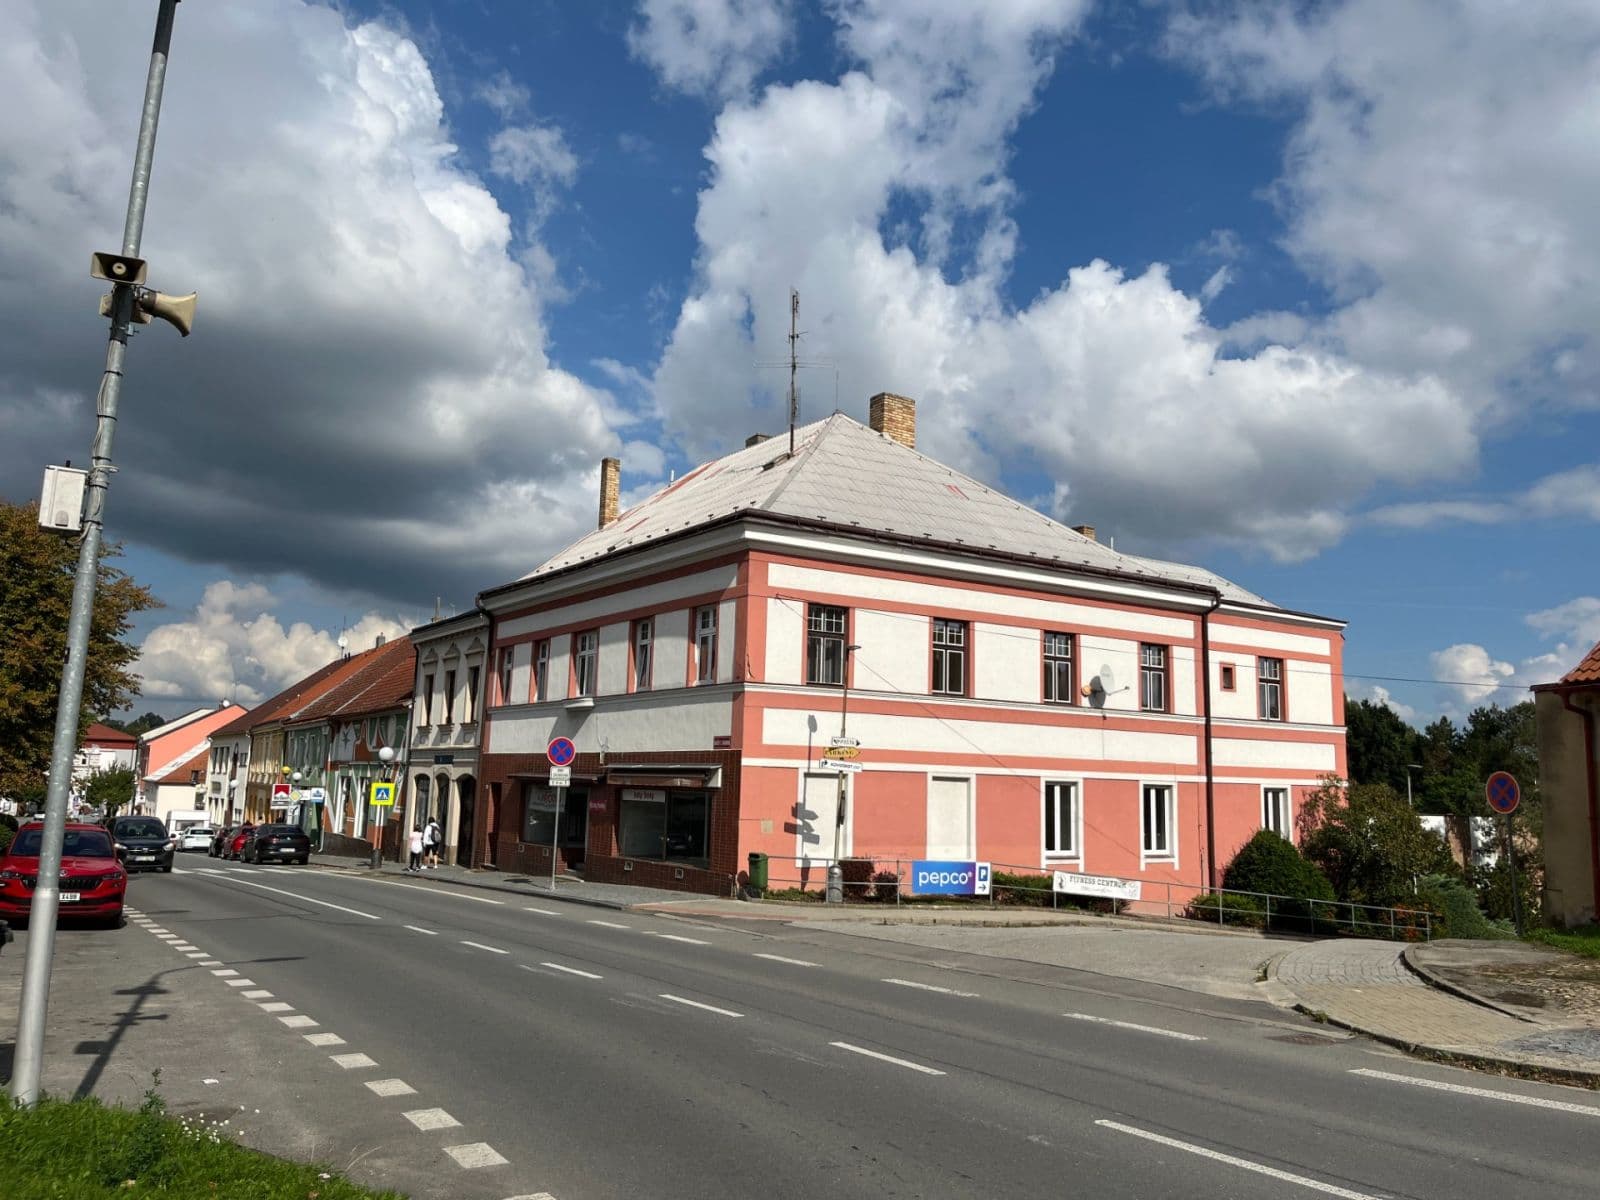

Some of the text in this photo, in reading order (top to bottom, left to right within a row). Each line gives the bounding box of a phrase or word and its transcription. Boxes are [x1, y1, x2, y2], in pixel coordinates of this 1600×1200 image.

[918, 871, 969, 887] pepco
[980, 868, 987, 880] P
[1069, 875, 1096, 885] FITNESS
